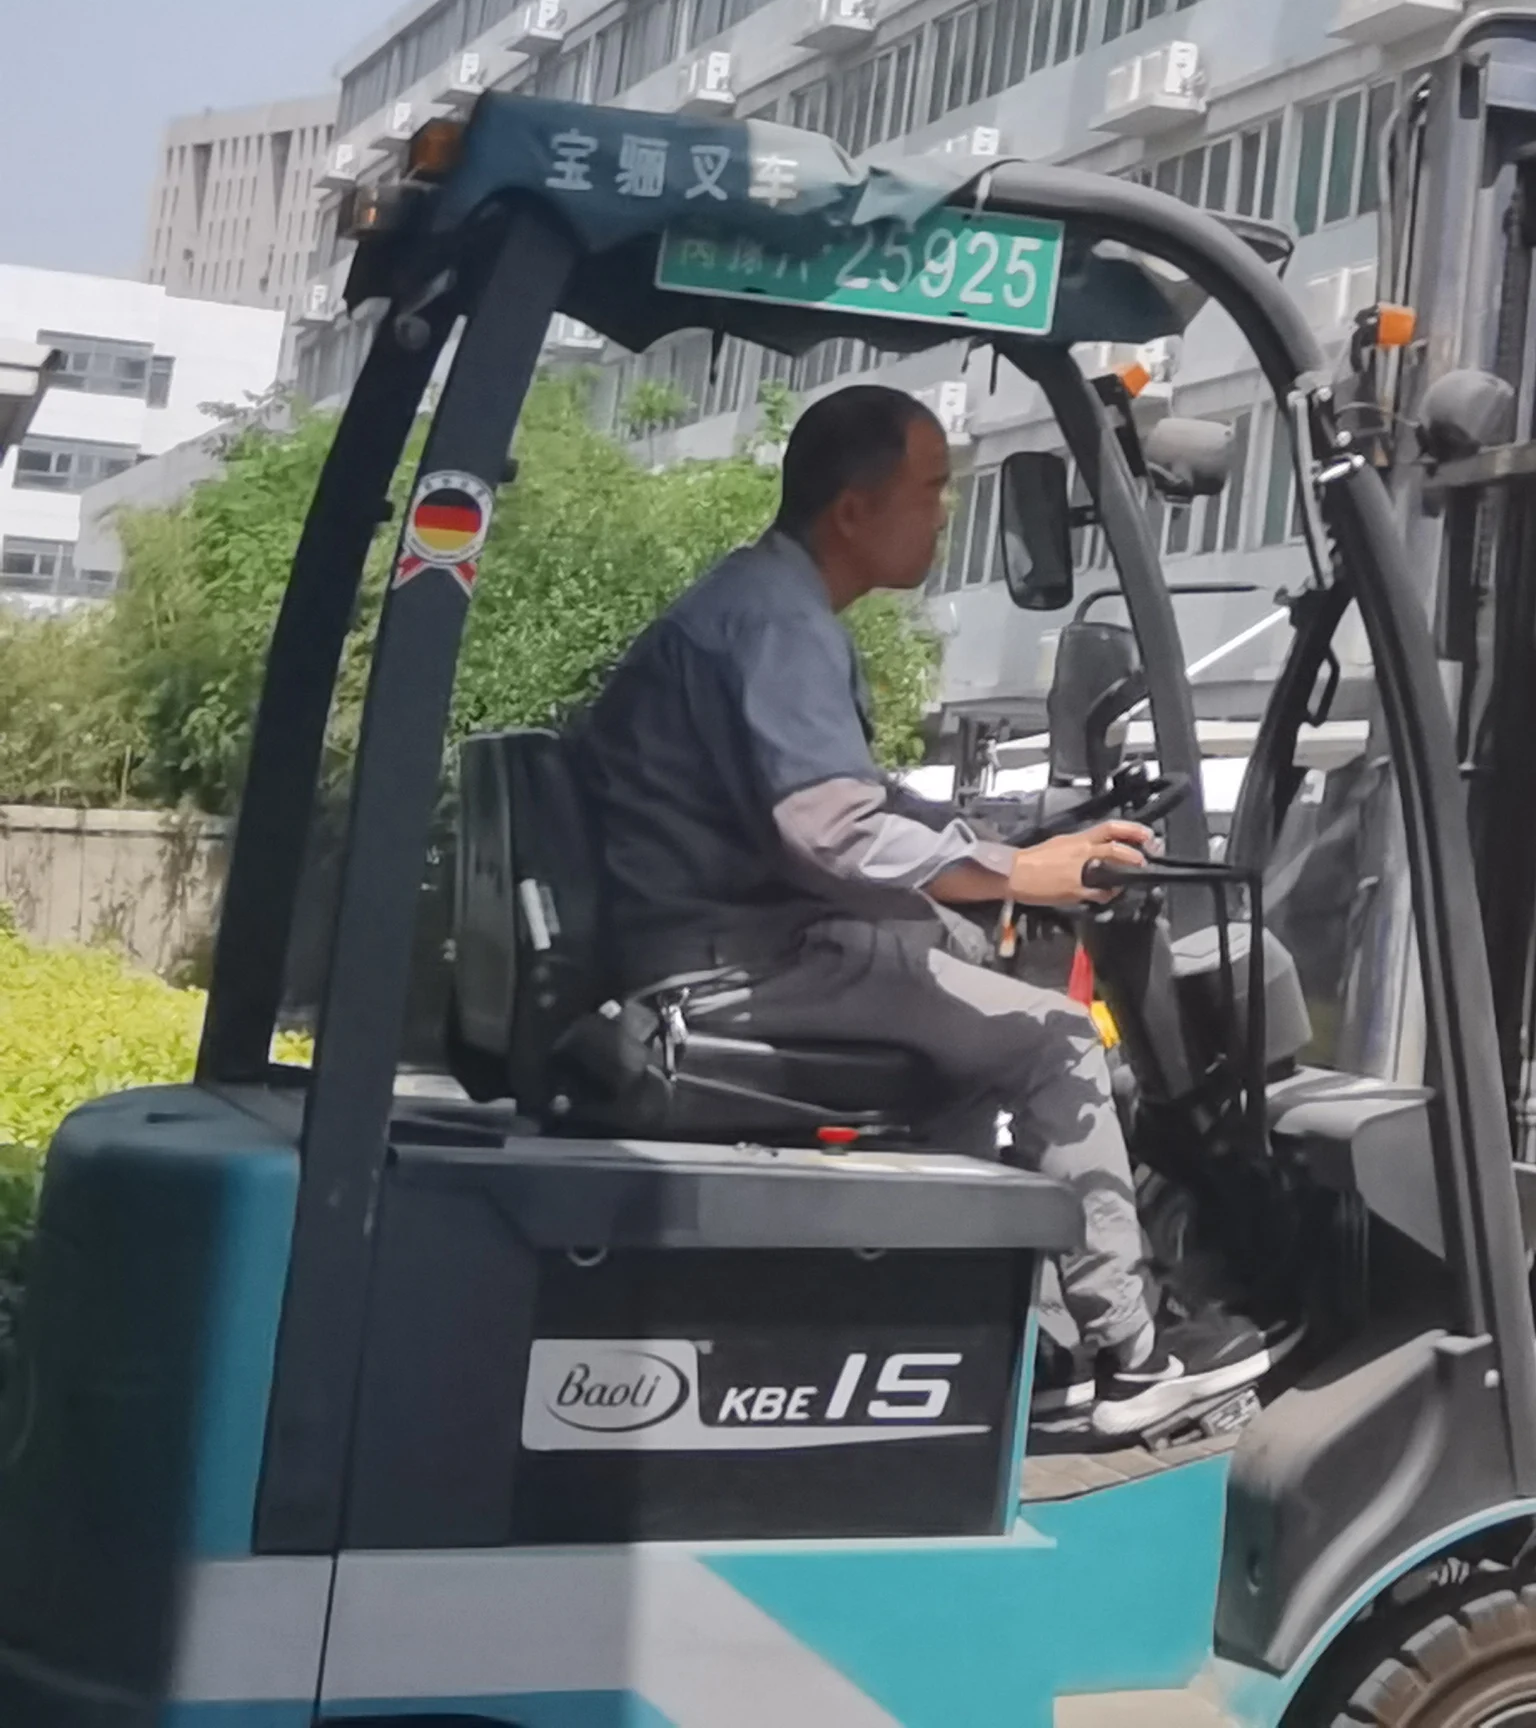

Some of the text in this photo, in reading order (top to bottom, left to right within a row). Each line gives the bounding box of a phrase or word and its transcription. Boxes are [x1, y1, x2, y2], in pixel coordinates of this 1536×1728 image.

[545, 128, 798, 208] 宝骊叉车
[556, 1363, 661, 1408] Baoli
[717, 1386, 818, 1422] KBE
